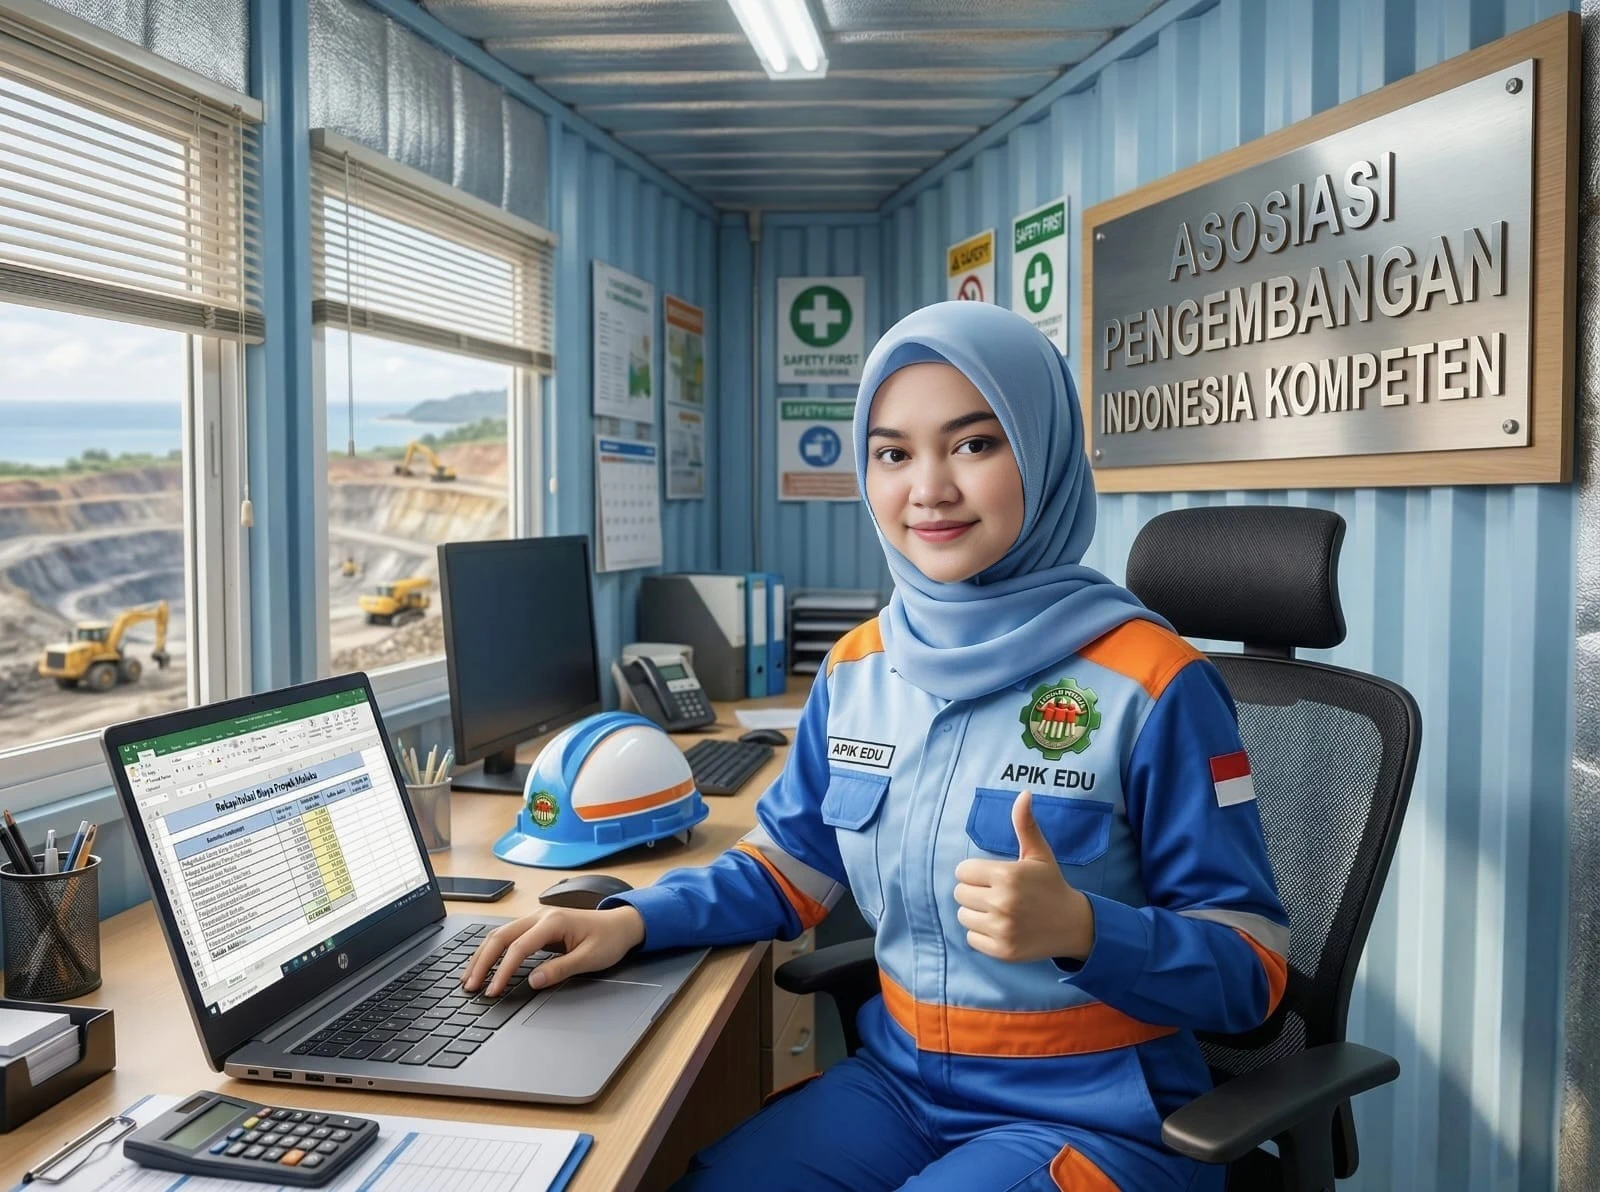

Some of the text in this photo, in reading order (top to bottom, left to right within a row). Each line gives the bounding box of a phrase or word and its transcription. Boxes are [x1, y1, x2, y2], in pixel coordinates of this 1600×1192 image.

[1015, 210, 1063, 245] SAFETY FIRST
[1168, 151, 1396, 282] ASOSIASI
[1103, 220, 1508, 371] PENGEMBANGAN
[783, 353, 859, 366] SAFETY FIRST
[1100, 332, 1505, 435] INDONESIA KOMPETEN
[785, 405, 825, 417] SAFETY
[832, 742, 885, 762] APIK EDU
[1000, 762, 1096, 792] APIK EDU
[337, 952, 349, 970] hp
